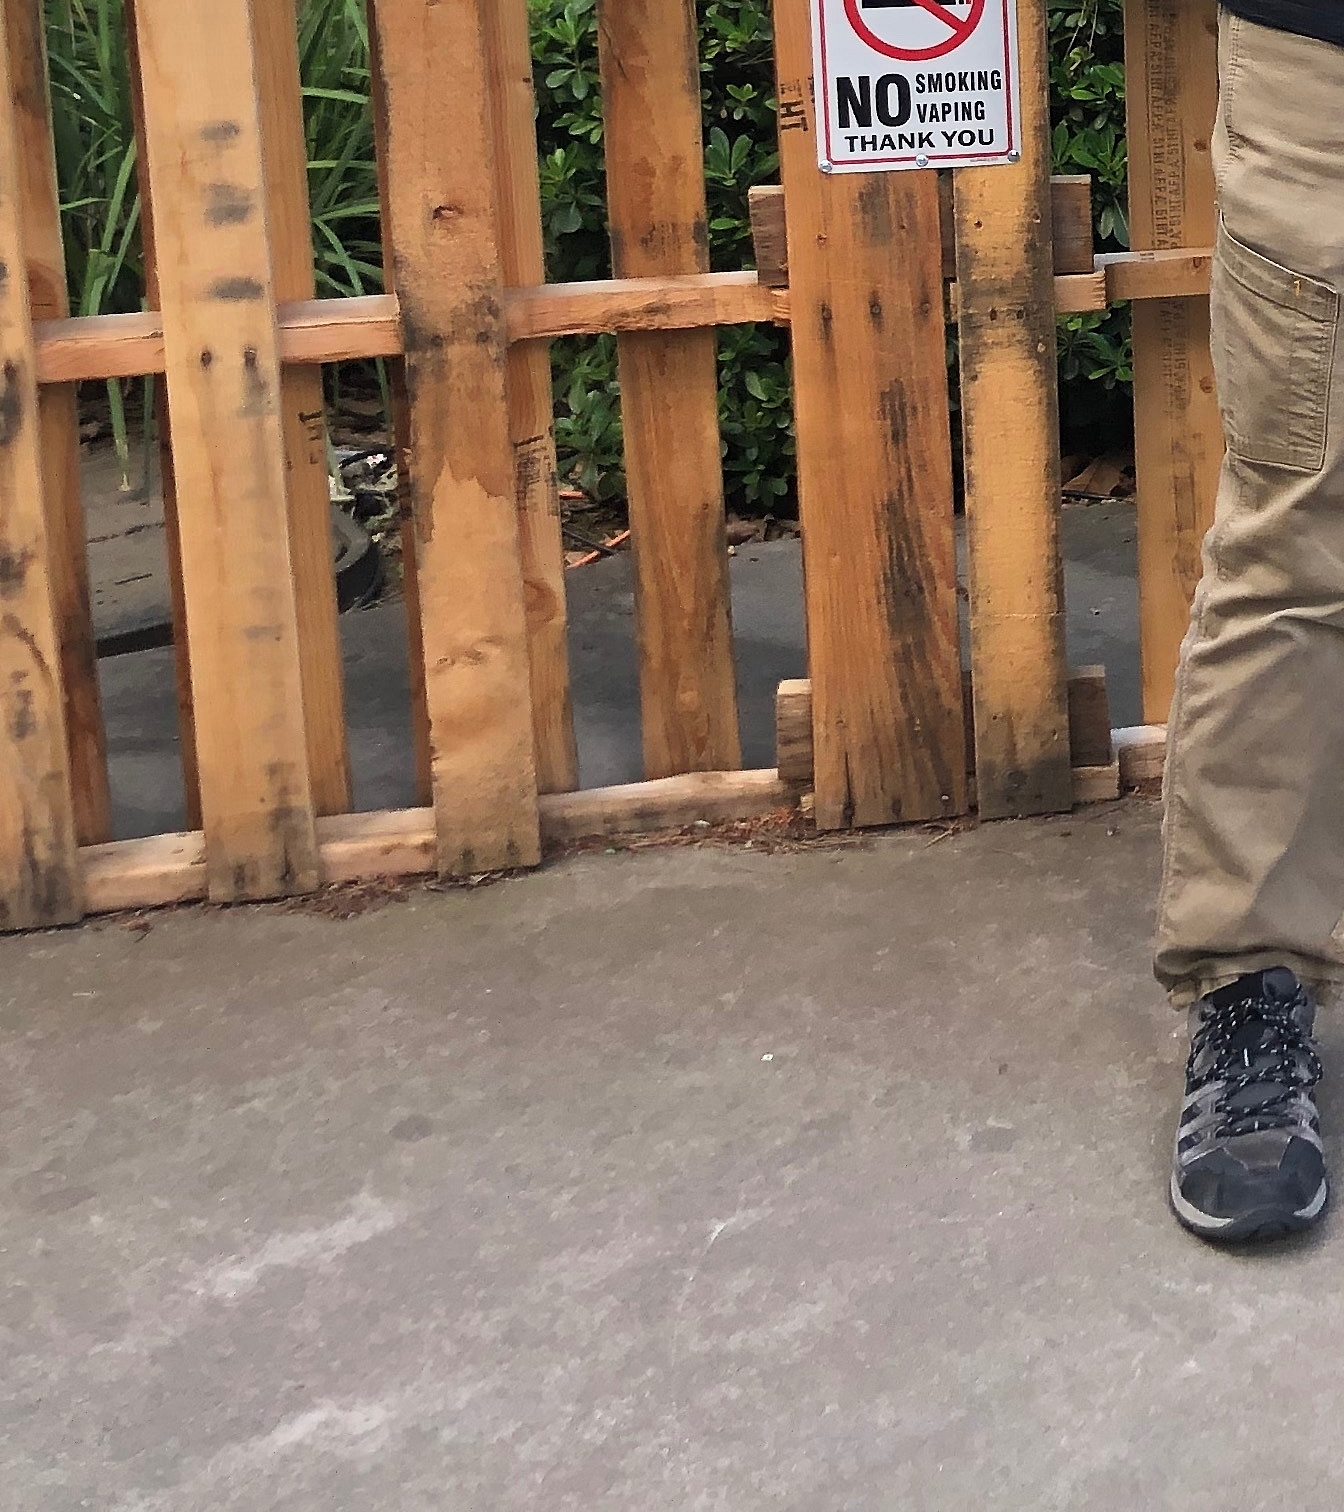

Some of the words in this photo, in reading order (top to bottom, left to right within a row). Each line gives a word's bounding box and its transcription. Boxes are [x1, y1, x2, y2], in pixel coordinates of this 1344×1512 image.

[836, 73, 911, 128] NO
[915, 70, 1001, 93] SMOKING
[916, 100, 985, 123] VAPING
[845, 131, 935, 152] THANK
[941, 129, 995, 147] YOU
